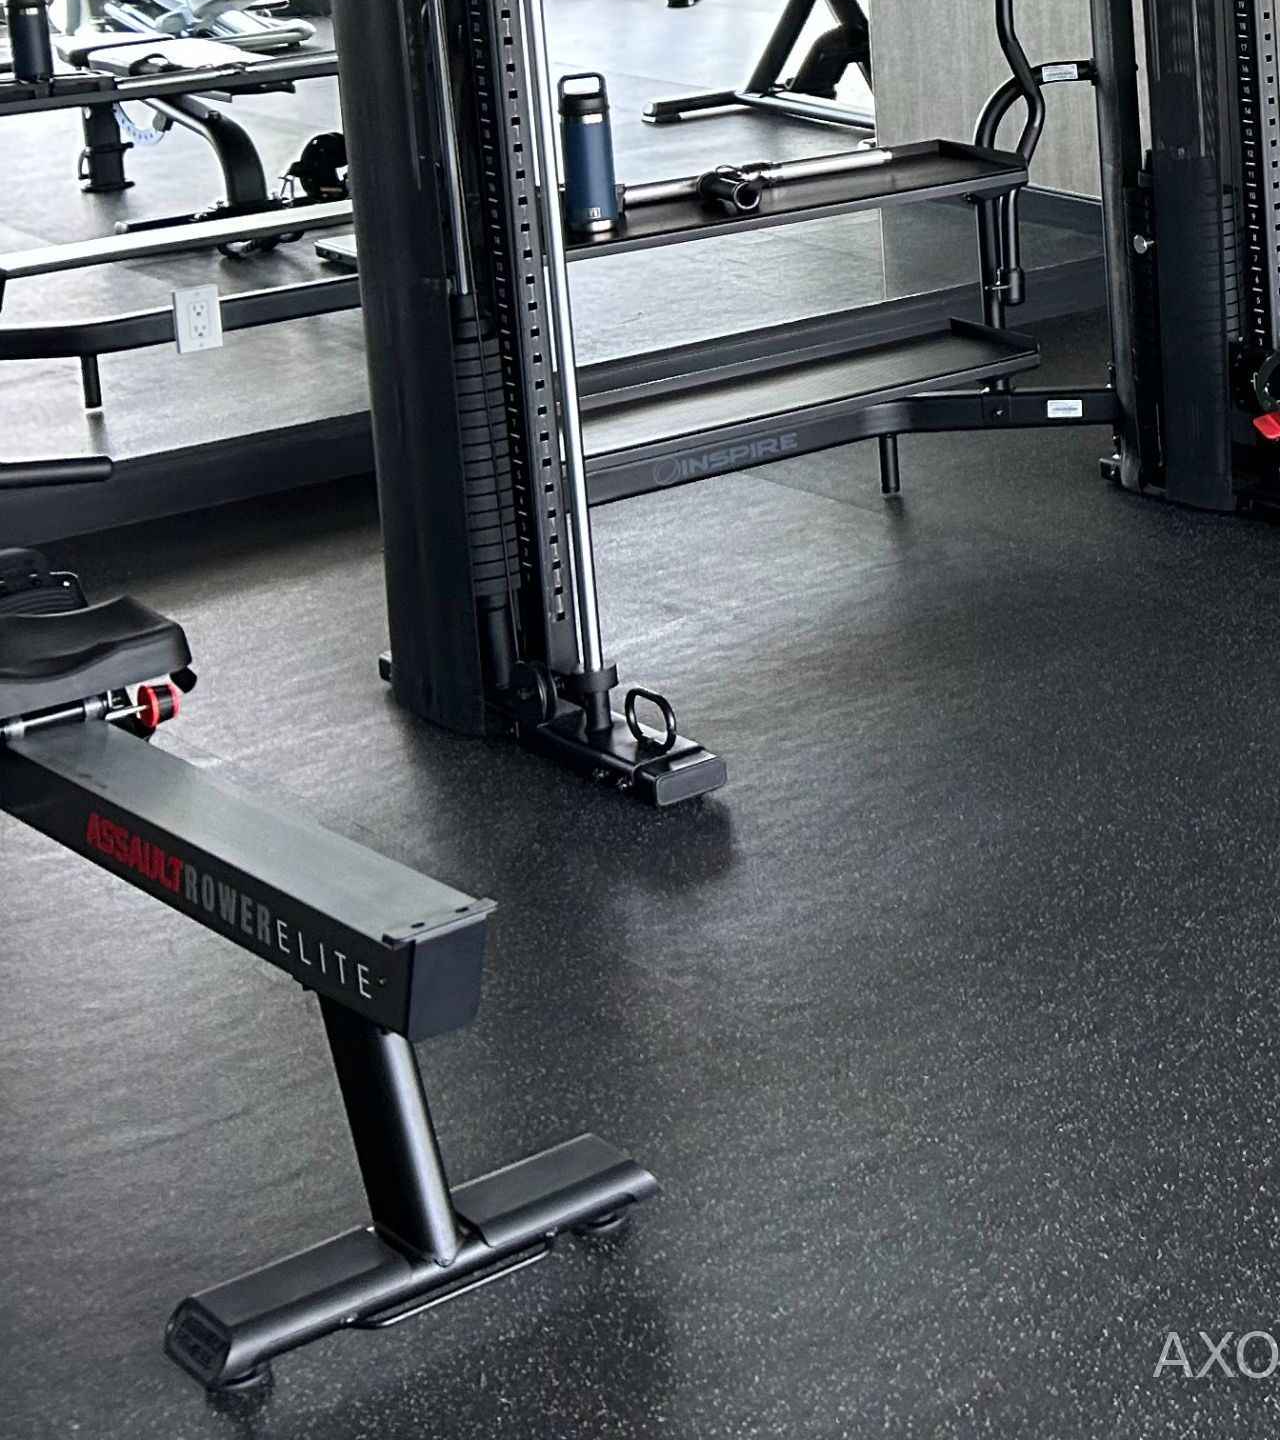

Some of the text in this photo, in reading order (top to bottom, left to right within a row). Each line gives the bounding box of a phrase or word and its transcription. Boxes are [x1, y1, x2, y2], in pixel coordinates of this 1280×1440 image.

[682, 432, 798, 477] INSPIRE
[86, 812, 372, 999] ASSAULT ROWER ELITE
